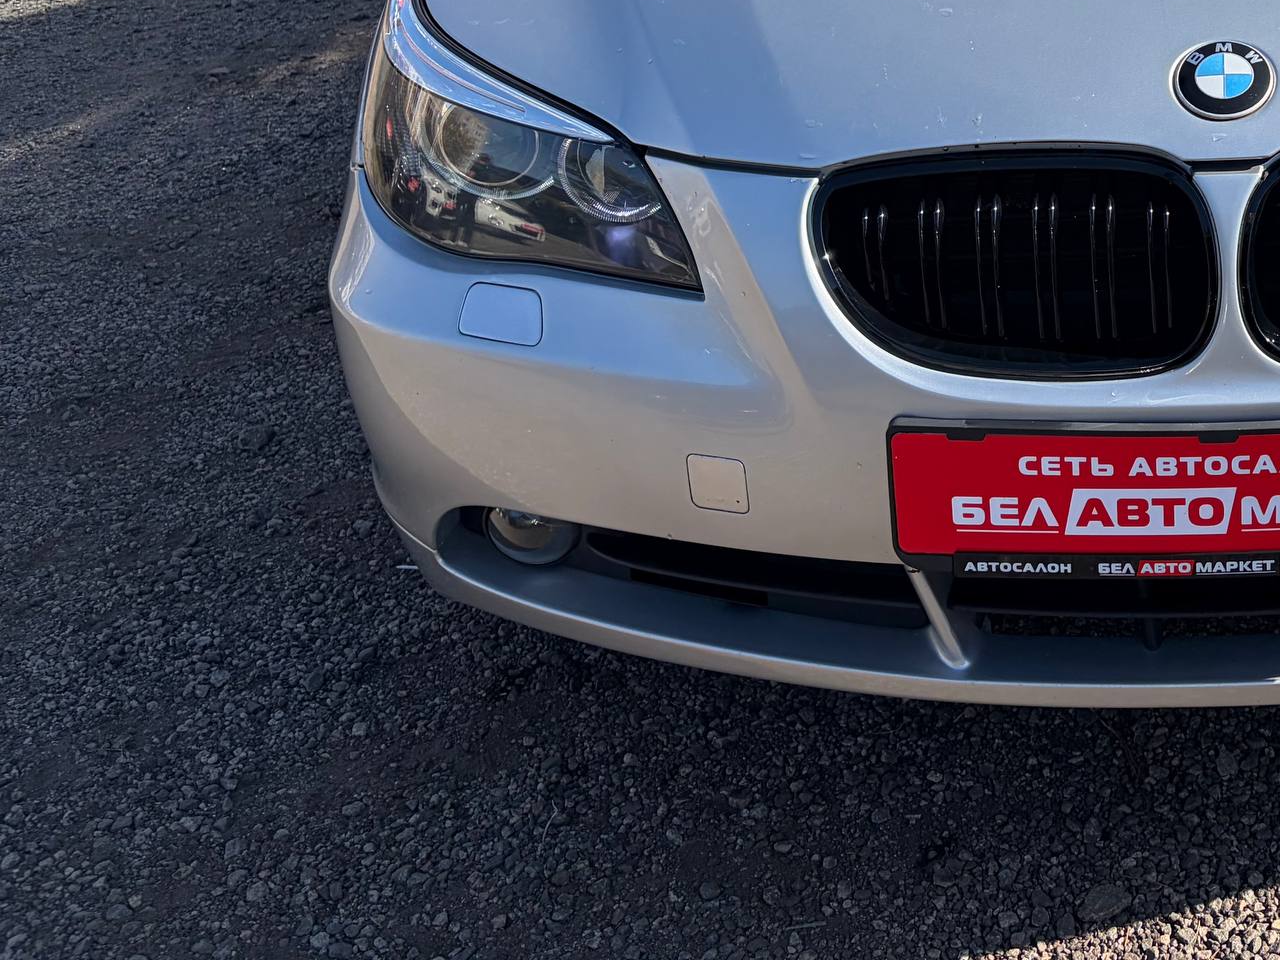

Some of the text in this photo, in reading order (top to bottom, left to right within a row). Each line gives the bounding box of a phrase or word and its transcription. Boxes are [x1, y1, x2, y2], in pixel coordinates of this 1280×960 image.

[1187, 42, 1264, 66] BMW
[1018, 456, 1115, 477] СЕТЬ
[964, 561, 1072, 574] АВТОСАЛОН
